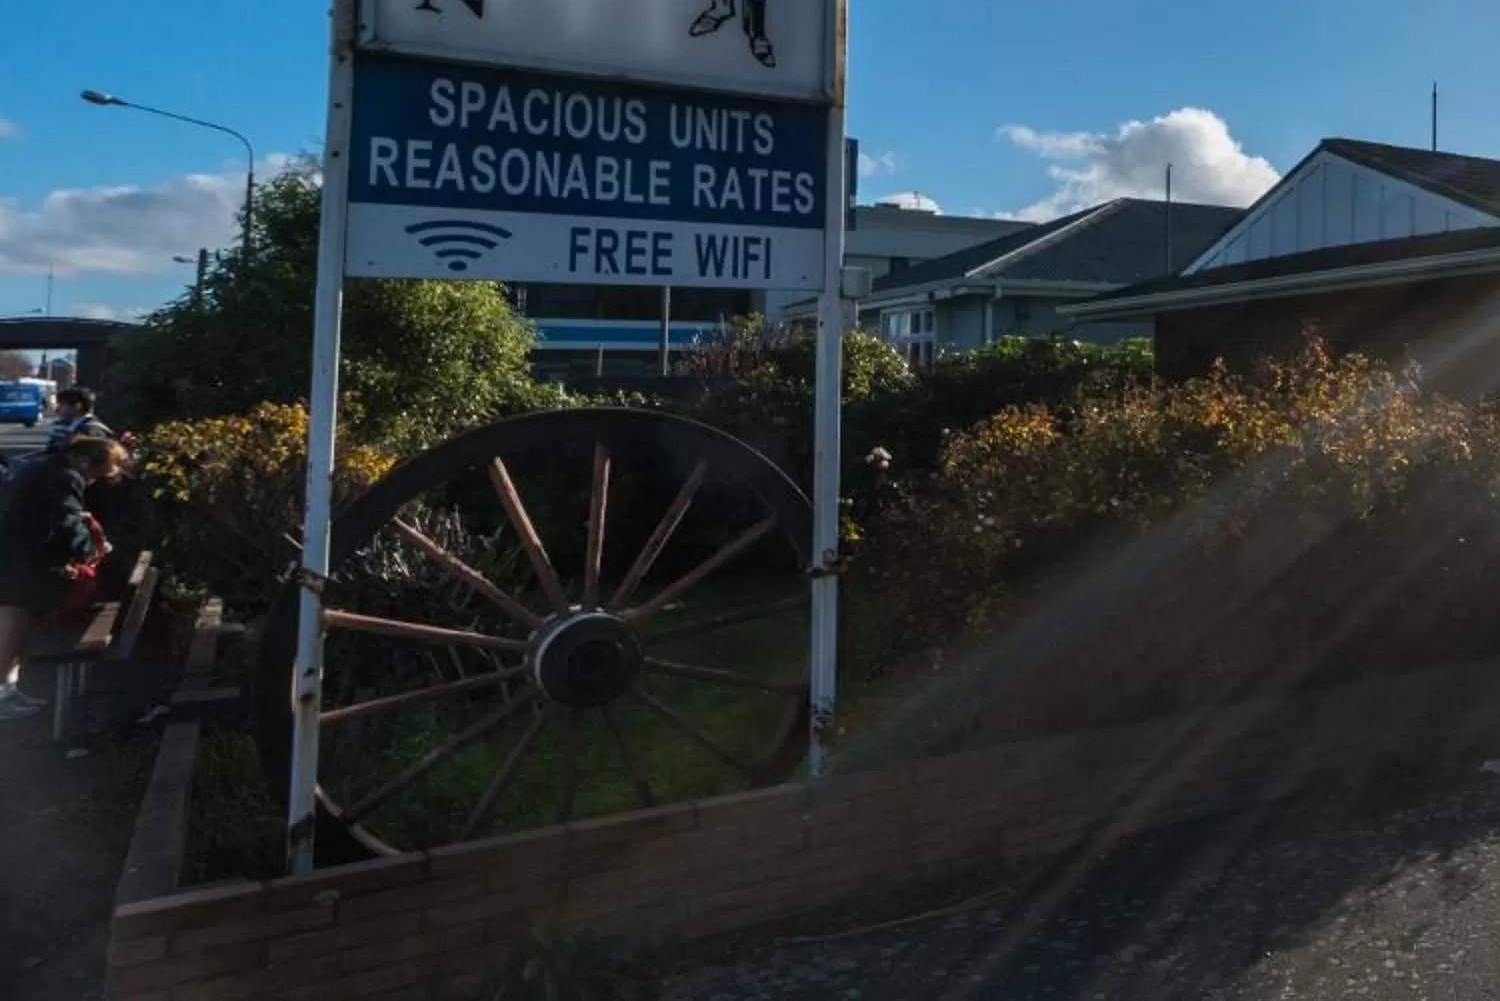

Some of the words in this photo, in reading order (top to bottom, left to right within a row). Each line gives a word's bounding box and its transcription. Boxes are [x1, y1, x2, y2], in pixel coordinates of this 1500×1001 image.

[429, 78, 647, 145] SPACIOUS
[669, 103, 774, 155] UNITS
[369, 136, 671, 206] REASONABLE
[692, 164, 815, 215] RATES
[569, 227, 673, 276] FREE
[695, 233, 771, 280] WIFI
